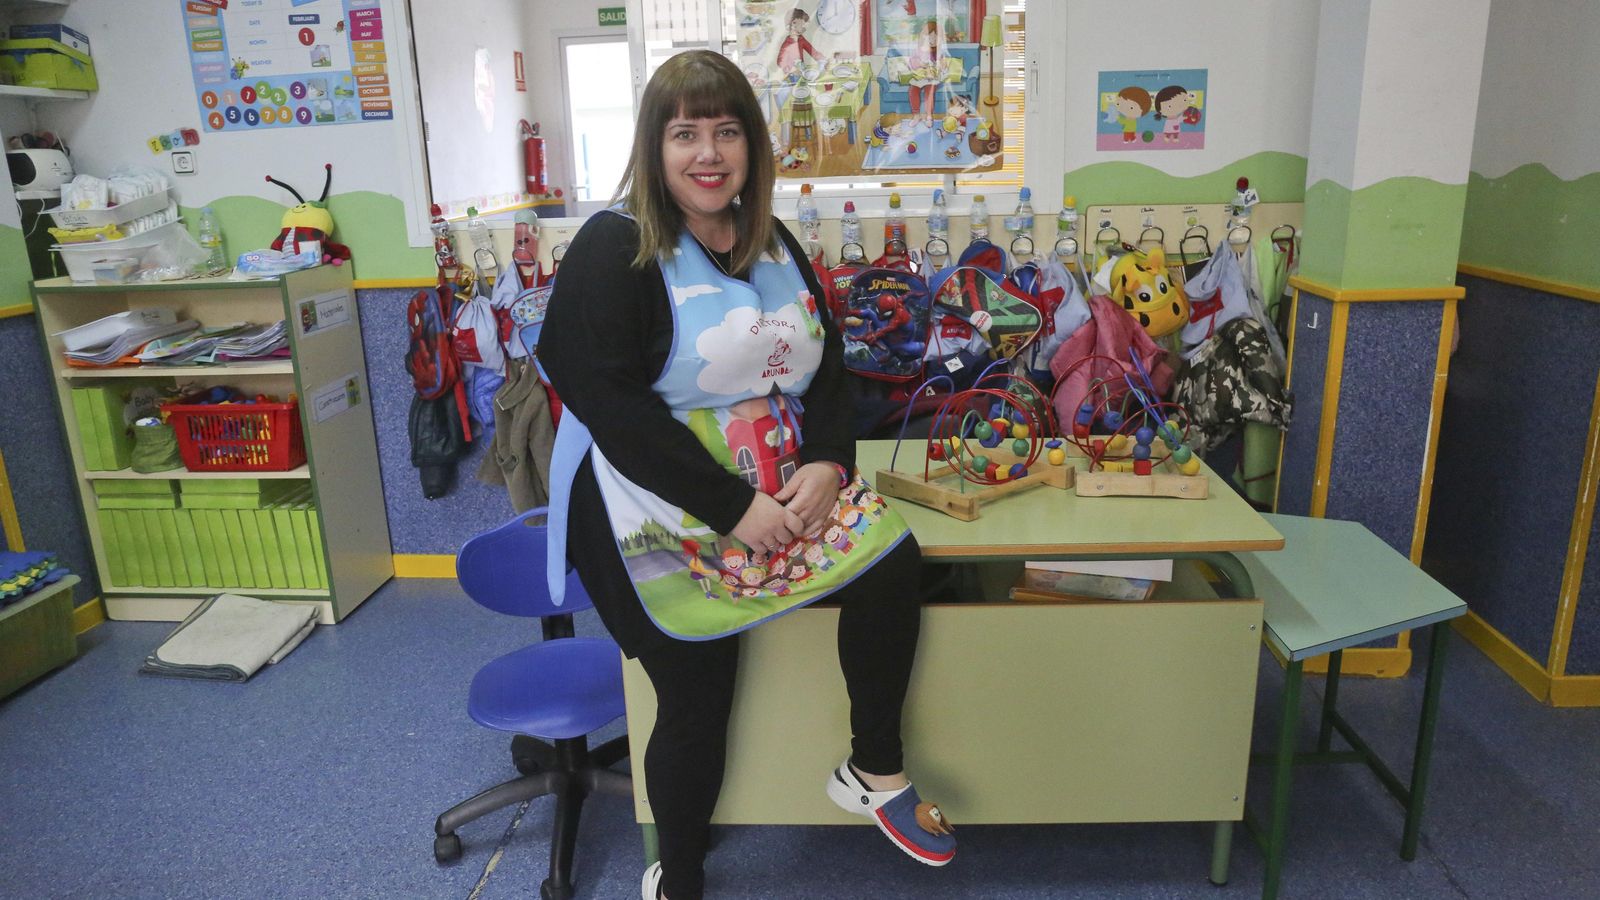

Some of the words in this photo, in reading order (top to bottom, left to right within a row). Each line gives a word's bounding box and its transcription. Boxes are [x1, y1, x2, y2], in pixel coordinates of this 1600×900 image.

[192, 4, 212, 13] TUESDAY
[600, 12, 626, 22] SALID
[303, 33, 309, 42] 1
[245, 91, 251, 100] 1
[259, 85, 266, 94] 2
[274, 93, 282, 102] 2
[294, 86, 301, 95] 3
[212, 117, 220, 126] 4
[230, 110, 236, 120] 5
[248, 112, 255, 121] 6
[264, 111, 271, 120] 7
[281, 110, 288, 120] 8
[301, 111, 307, 120] 9
